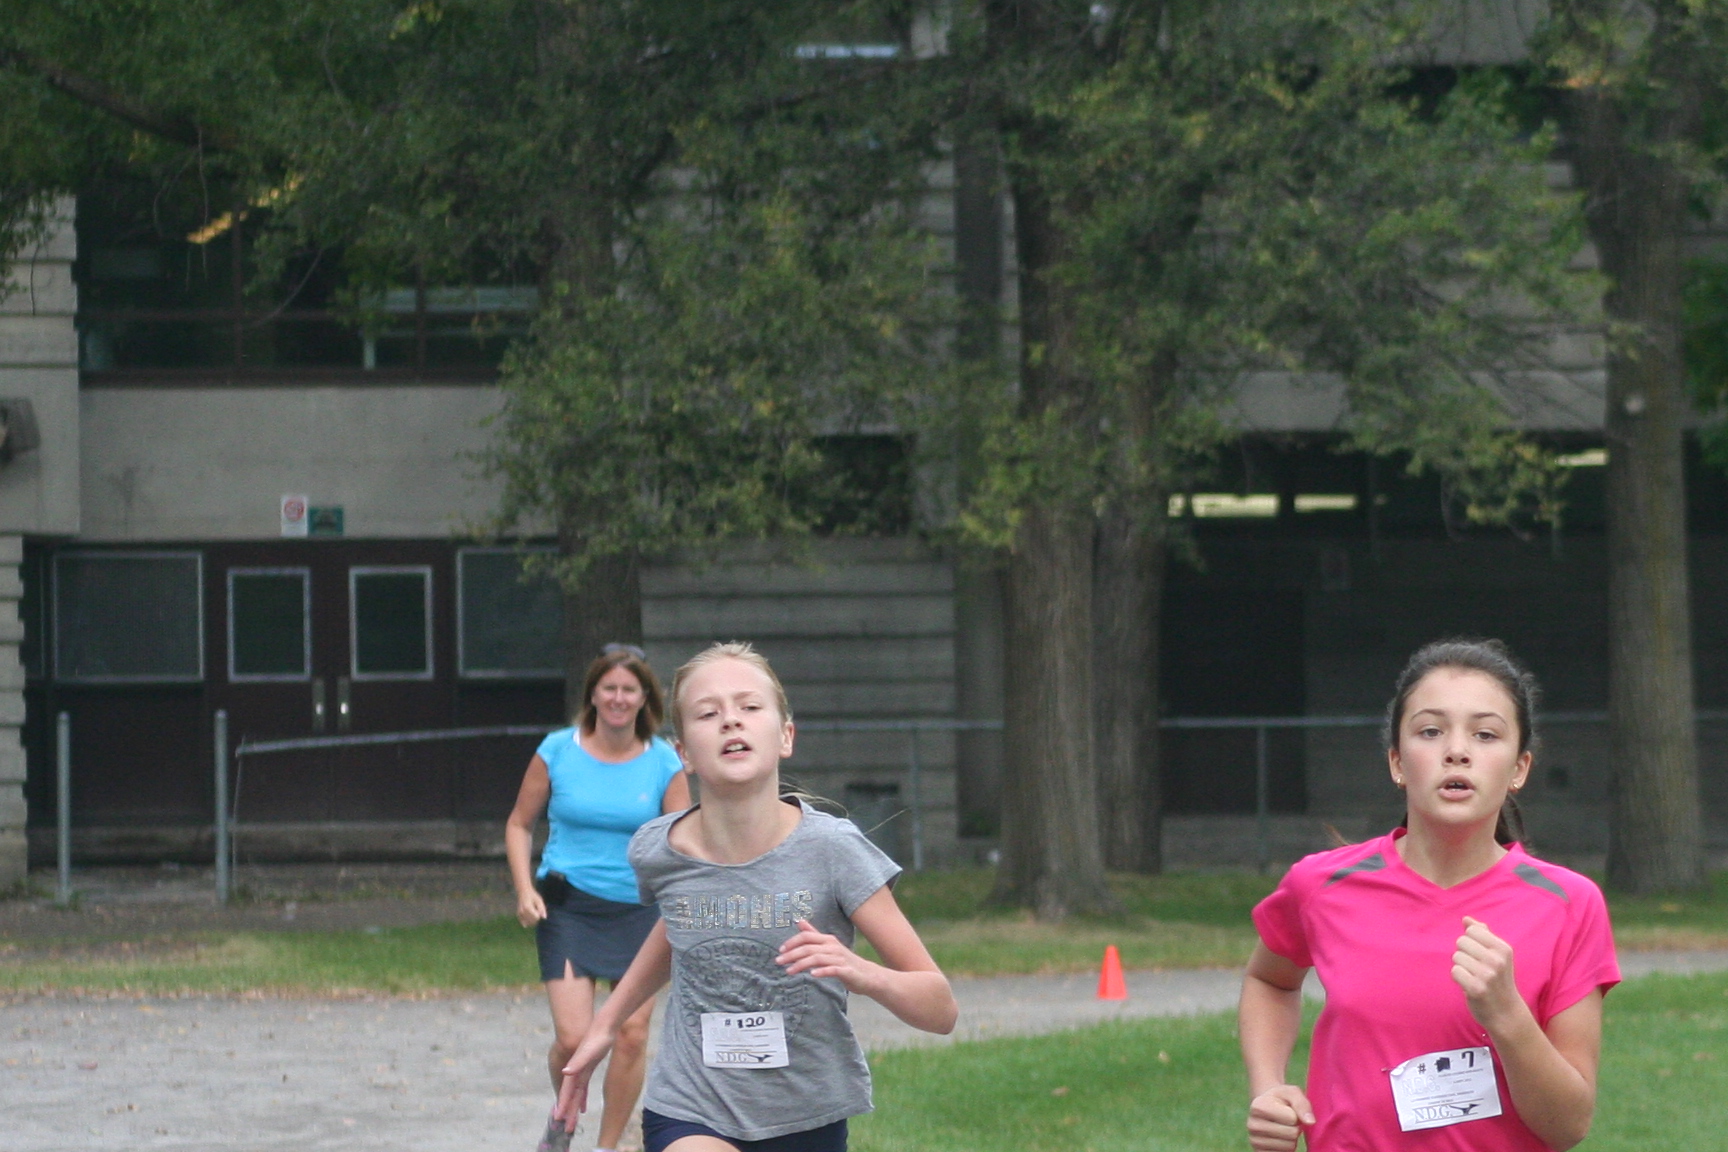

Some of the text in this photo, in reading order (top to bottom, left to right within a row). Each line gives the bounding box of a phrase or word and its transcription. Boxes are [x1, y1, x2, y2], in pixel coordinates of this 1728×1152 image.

[737, 1016, 766, 1029] 120
[1417, 1062, 1427, 1075] #
[1461, 1050, 1475, 1069] 7
